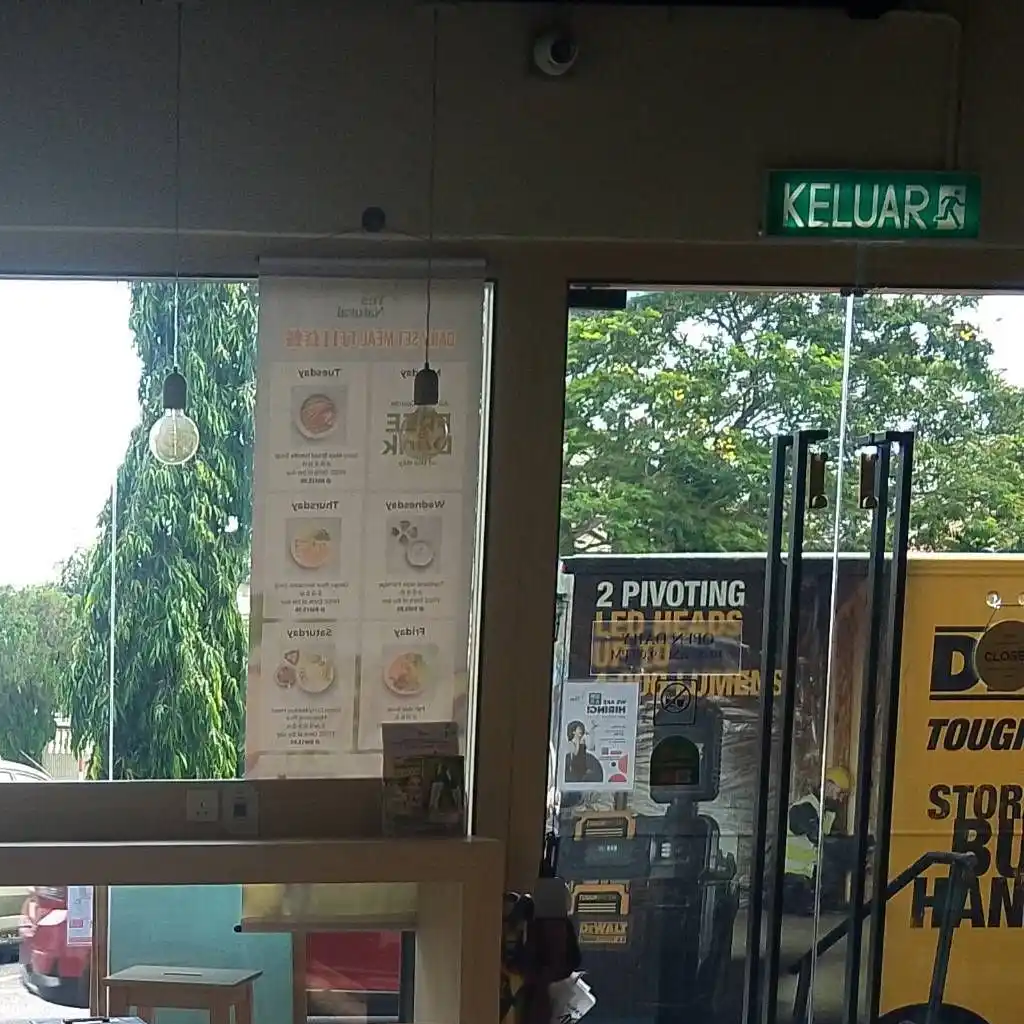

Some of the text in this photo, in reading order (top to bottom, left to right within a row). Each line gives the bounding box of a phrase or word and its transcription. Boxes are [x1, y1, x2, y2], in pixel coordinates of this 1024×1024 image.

[783, 182, 930, 229] KELUAR
[596, 579, 746, 608] 2 PIVOTING
[595, 610, 744, 638] LED HEADS
[928, 784, 1024, 819] STOR
[910, 877, 1024, 928] HAN
